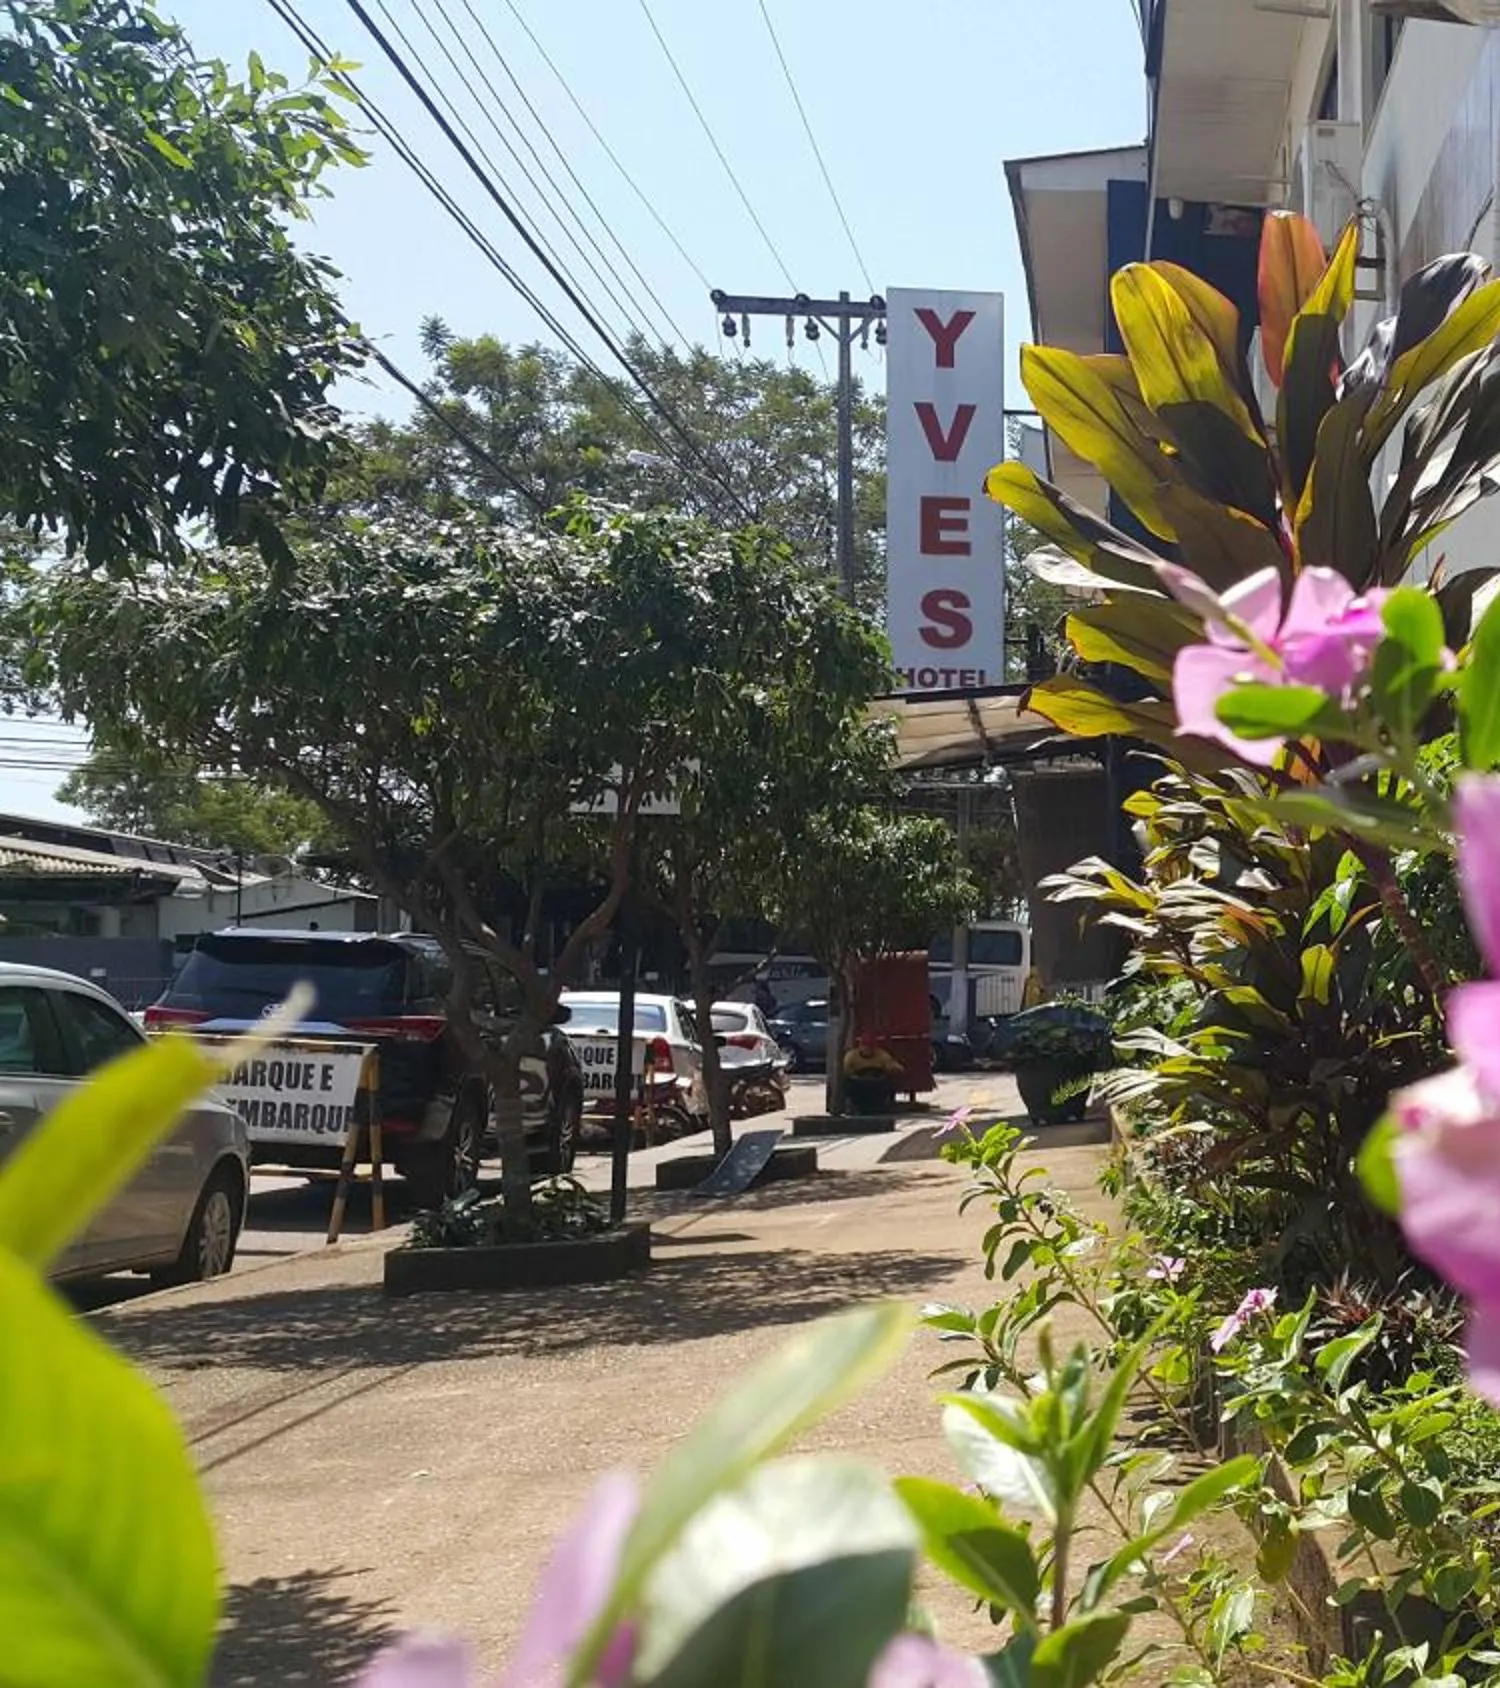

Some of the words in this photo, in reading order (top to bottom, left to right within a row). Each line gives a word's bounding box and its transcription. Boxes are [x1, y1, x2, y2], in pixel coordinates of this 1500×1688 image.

[914, 308, 977, 650] YVES
[320, 1064, 334, 1091] E
[227, 1098, 353, 1134] MBARQU
